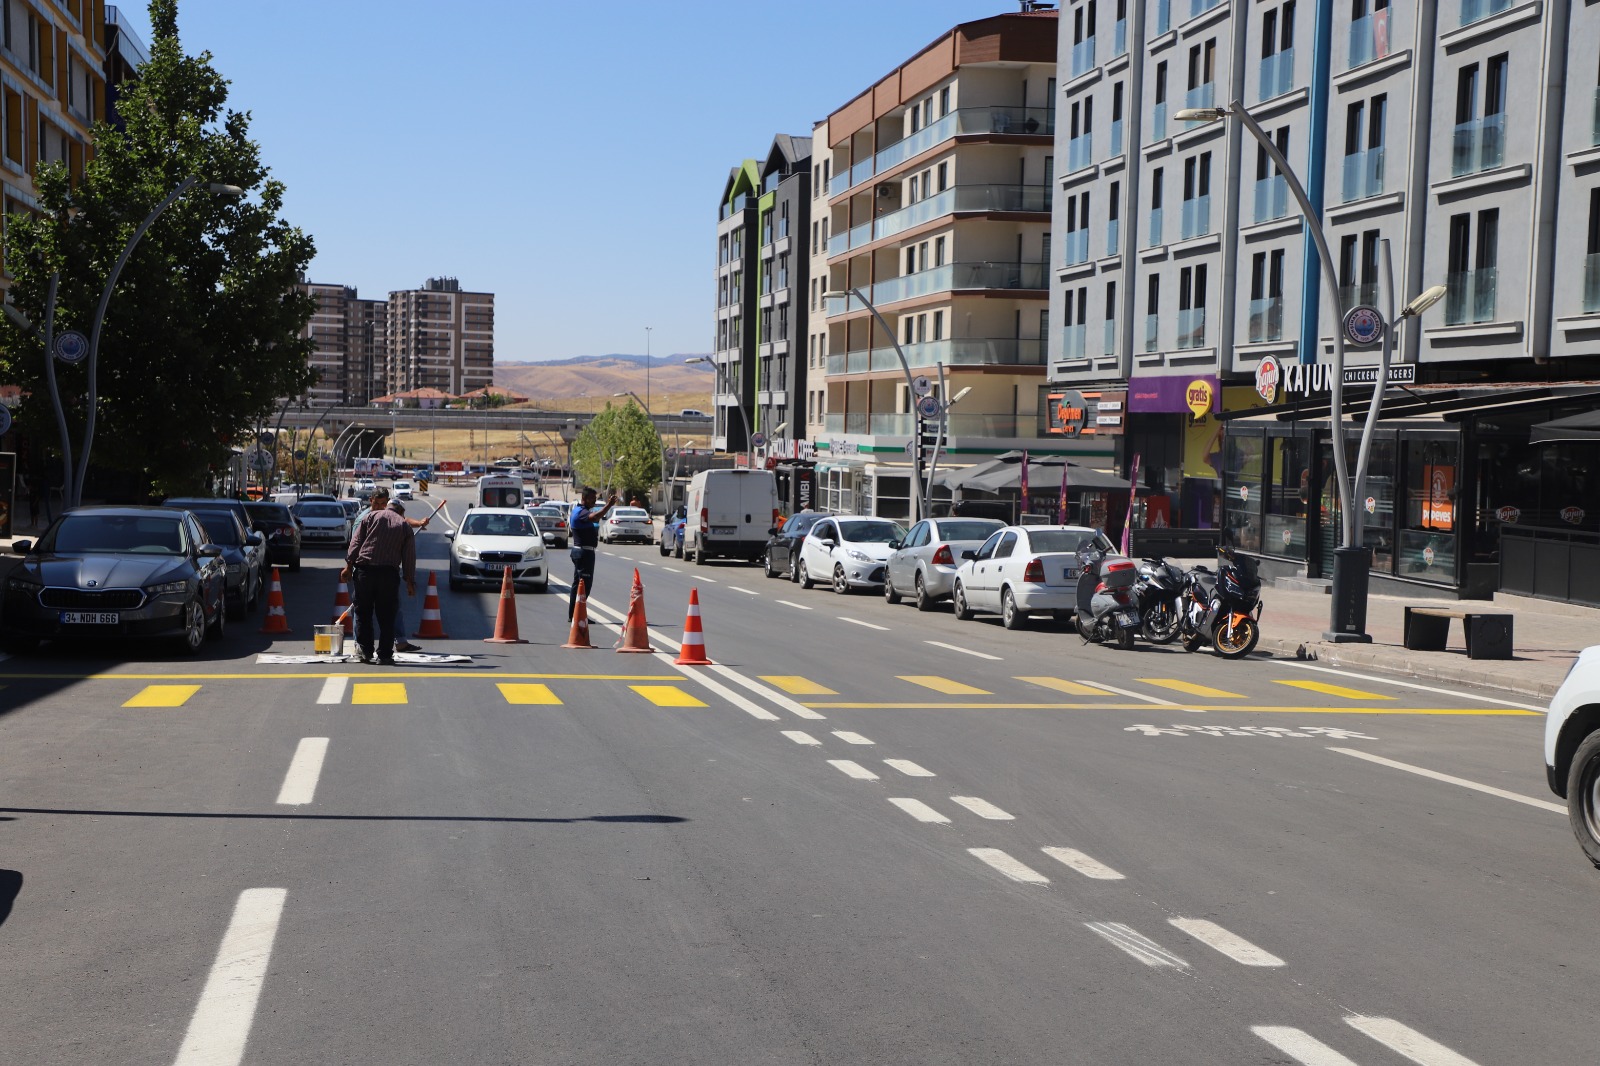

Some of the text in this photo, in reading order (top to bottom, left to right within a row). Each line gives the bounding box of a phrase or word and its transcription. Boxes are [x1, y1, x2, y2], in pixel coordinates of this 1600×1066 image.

[1284, 364, 1334, 398] KAJUN
[1188, 386, 1207, 405] gratis
[65, 613, 116, 623] 34 NDH 666
